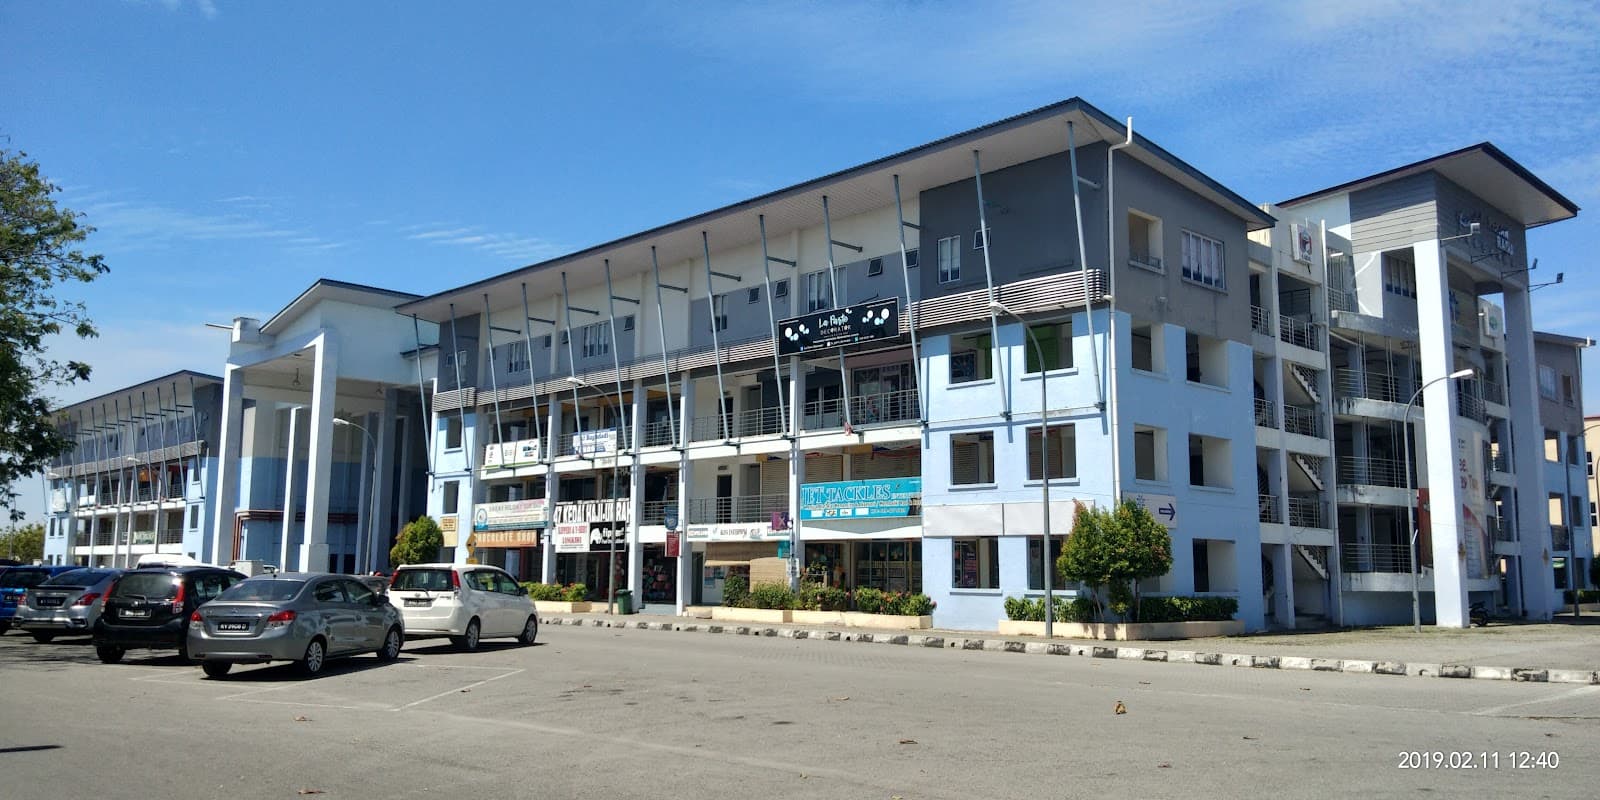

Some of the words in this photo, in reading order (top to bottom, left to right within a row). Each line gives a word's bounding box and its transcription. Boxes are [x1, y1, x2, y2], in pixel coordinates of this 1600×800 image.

[801, 486, 825, 505] JET
[826, 484, 891, 502] TACKLES
[564, 503, 585, 523] KEDAI
